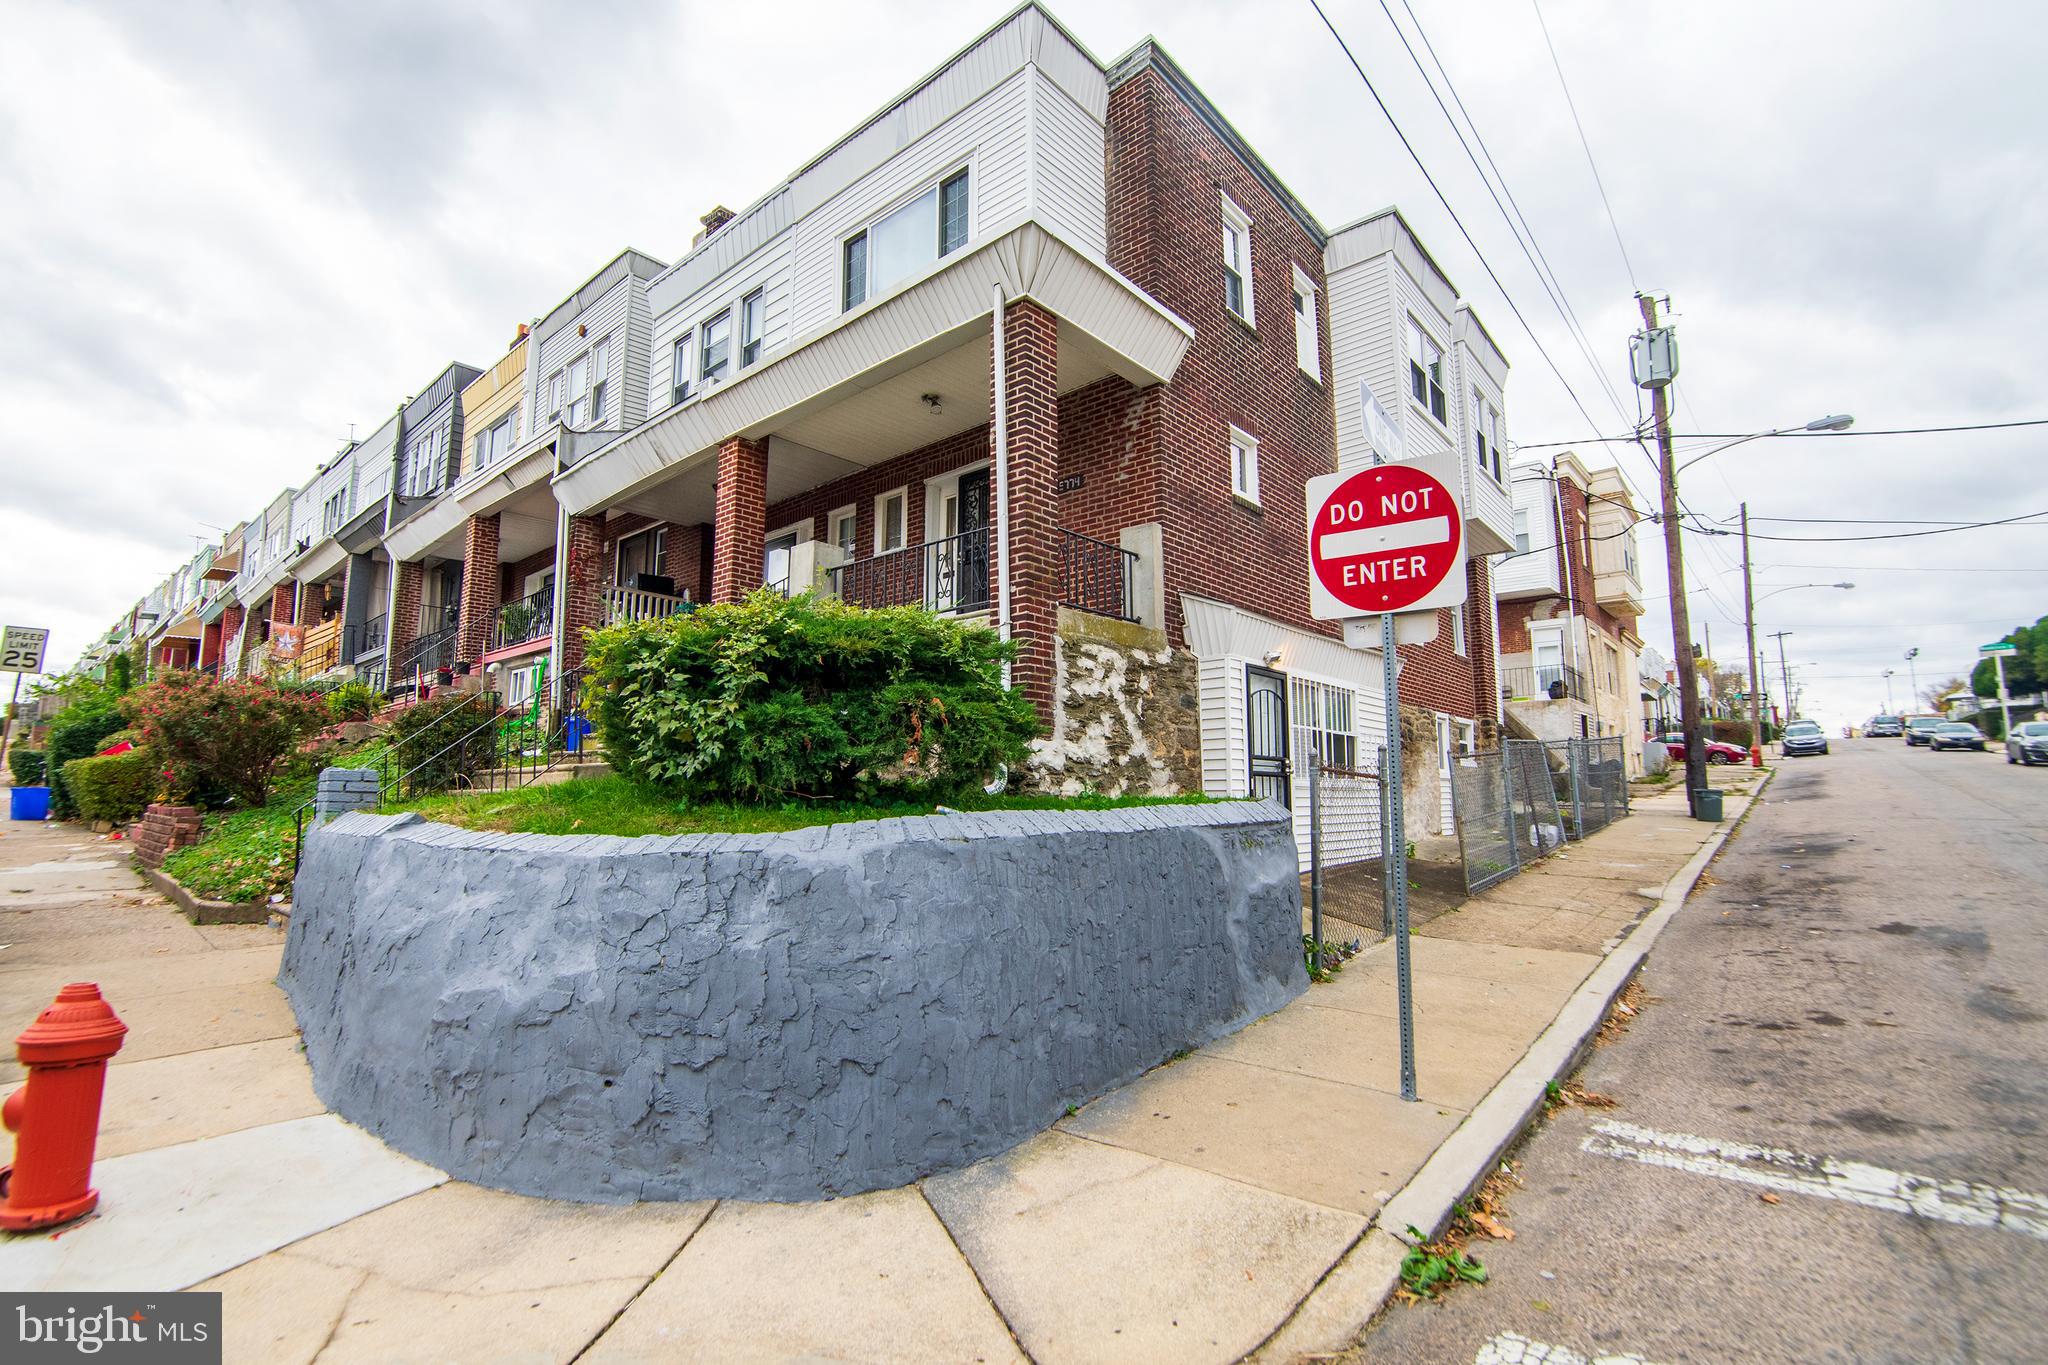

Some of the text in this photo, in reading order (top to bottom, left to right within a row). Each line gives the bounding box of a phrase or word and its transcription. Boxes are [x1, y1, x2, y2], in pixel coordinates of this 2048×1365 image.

[1330, 487, 1433, 525] DO NOT
[1343, 555, 1427, 587] ENTER
[7, 631, 45, 641] SPEED
[9, 640, 39, 650] LIMIT
[2, 650, 38, 668] 25
